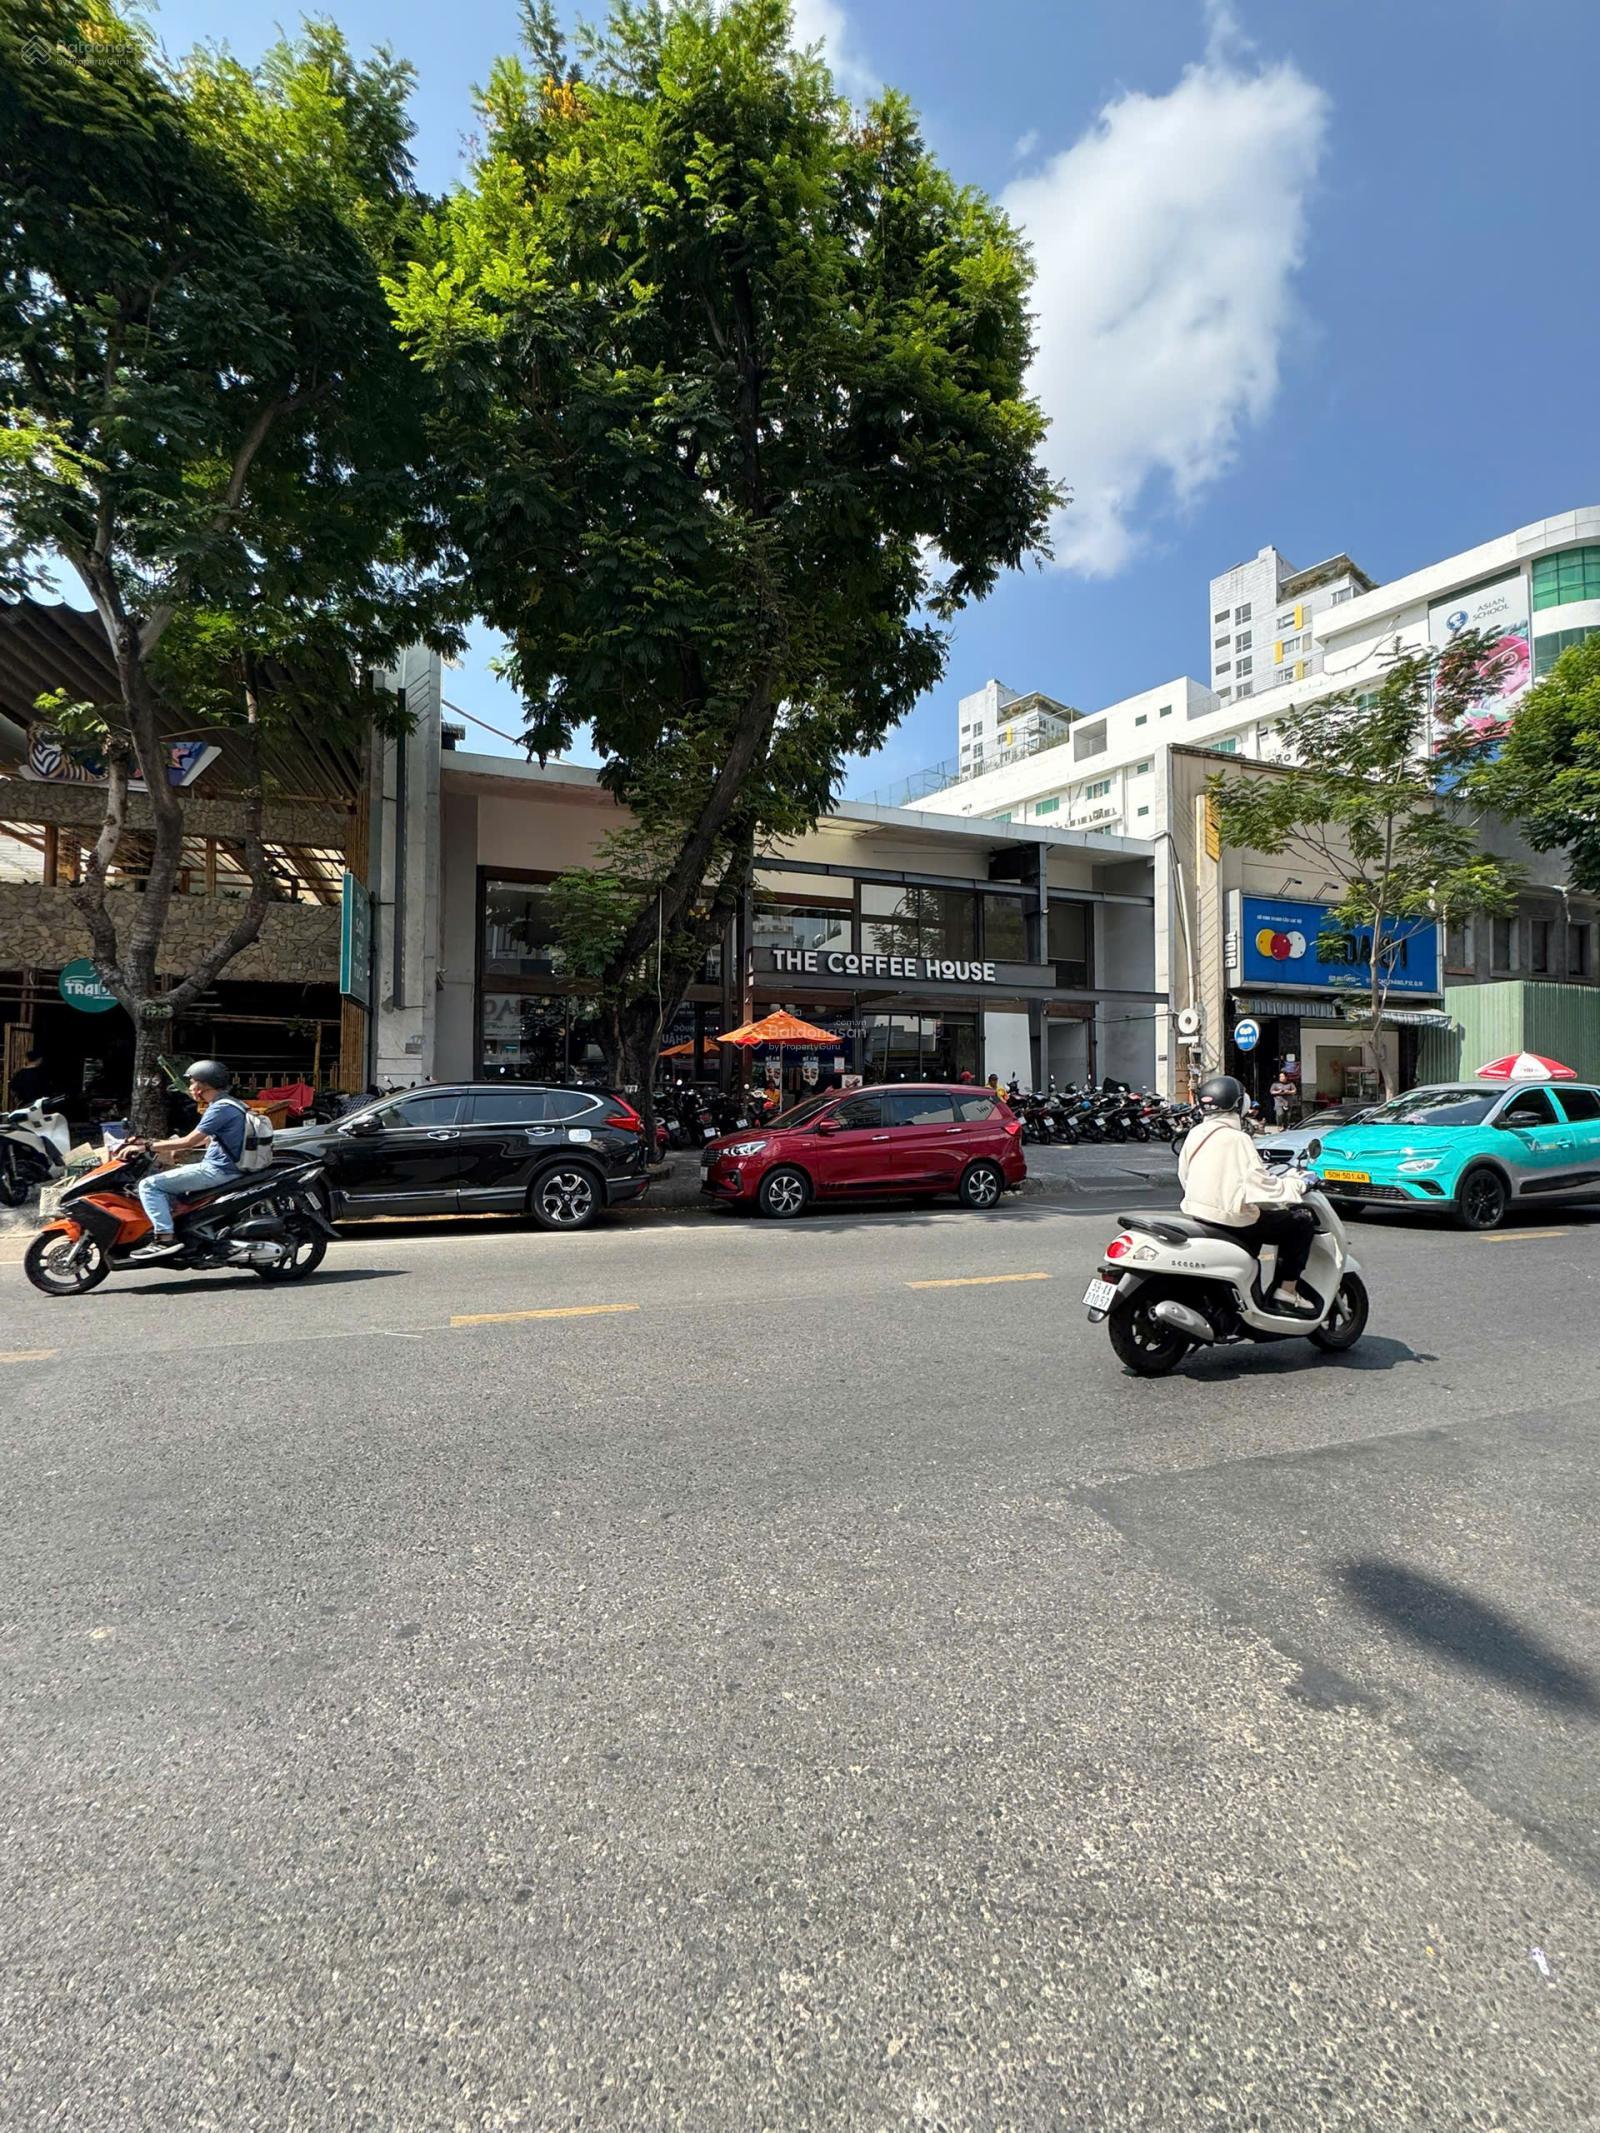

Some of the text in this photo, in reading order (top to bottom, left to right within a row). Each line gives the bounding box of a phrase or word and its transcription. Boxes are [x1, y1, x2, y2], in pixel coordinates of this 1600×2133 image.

[1473, 603, 1510, 621] SCHOOL
[1477, 597, 1505, 612] ASIAN
[1225, 930, 1237, 968] BIDA
[772, 950, 996, 982] THE COFFEE HOUSE
[136, 1077, 160, 1086] 175
